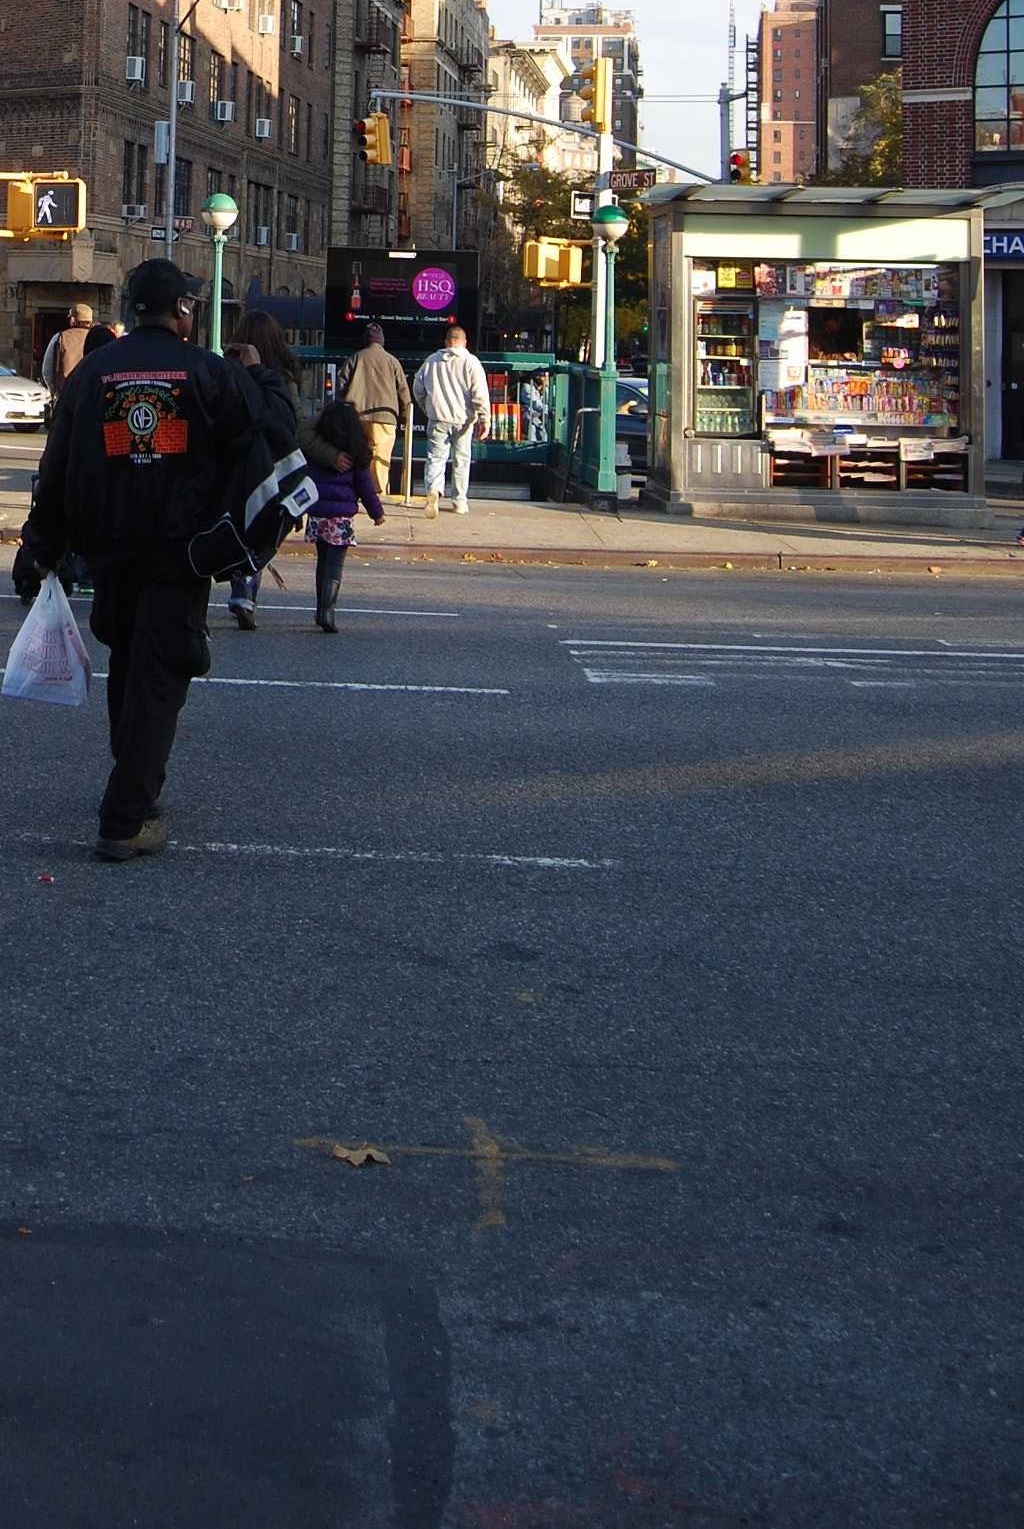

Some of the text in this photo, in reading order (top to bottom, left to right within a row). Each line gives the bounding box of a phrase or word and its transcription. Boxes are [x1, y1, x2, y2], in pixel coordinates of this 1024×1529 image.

[610, 172, 655, 188] GROVE ST
[417, 279, 455, 295] HSQ
[416, 292, 449, 301] BEAUTY
